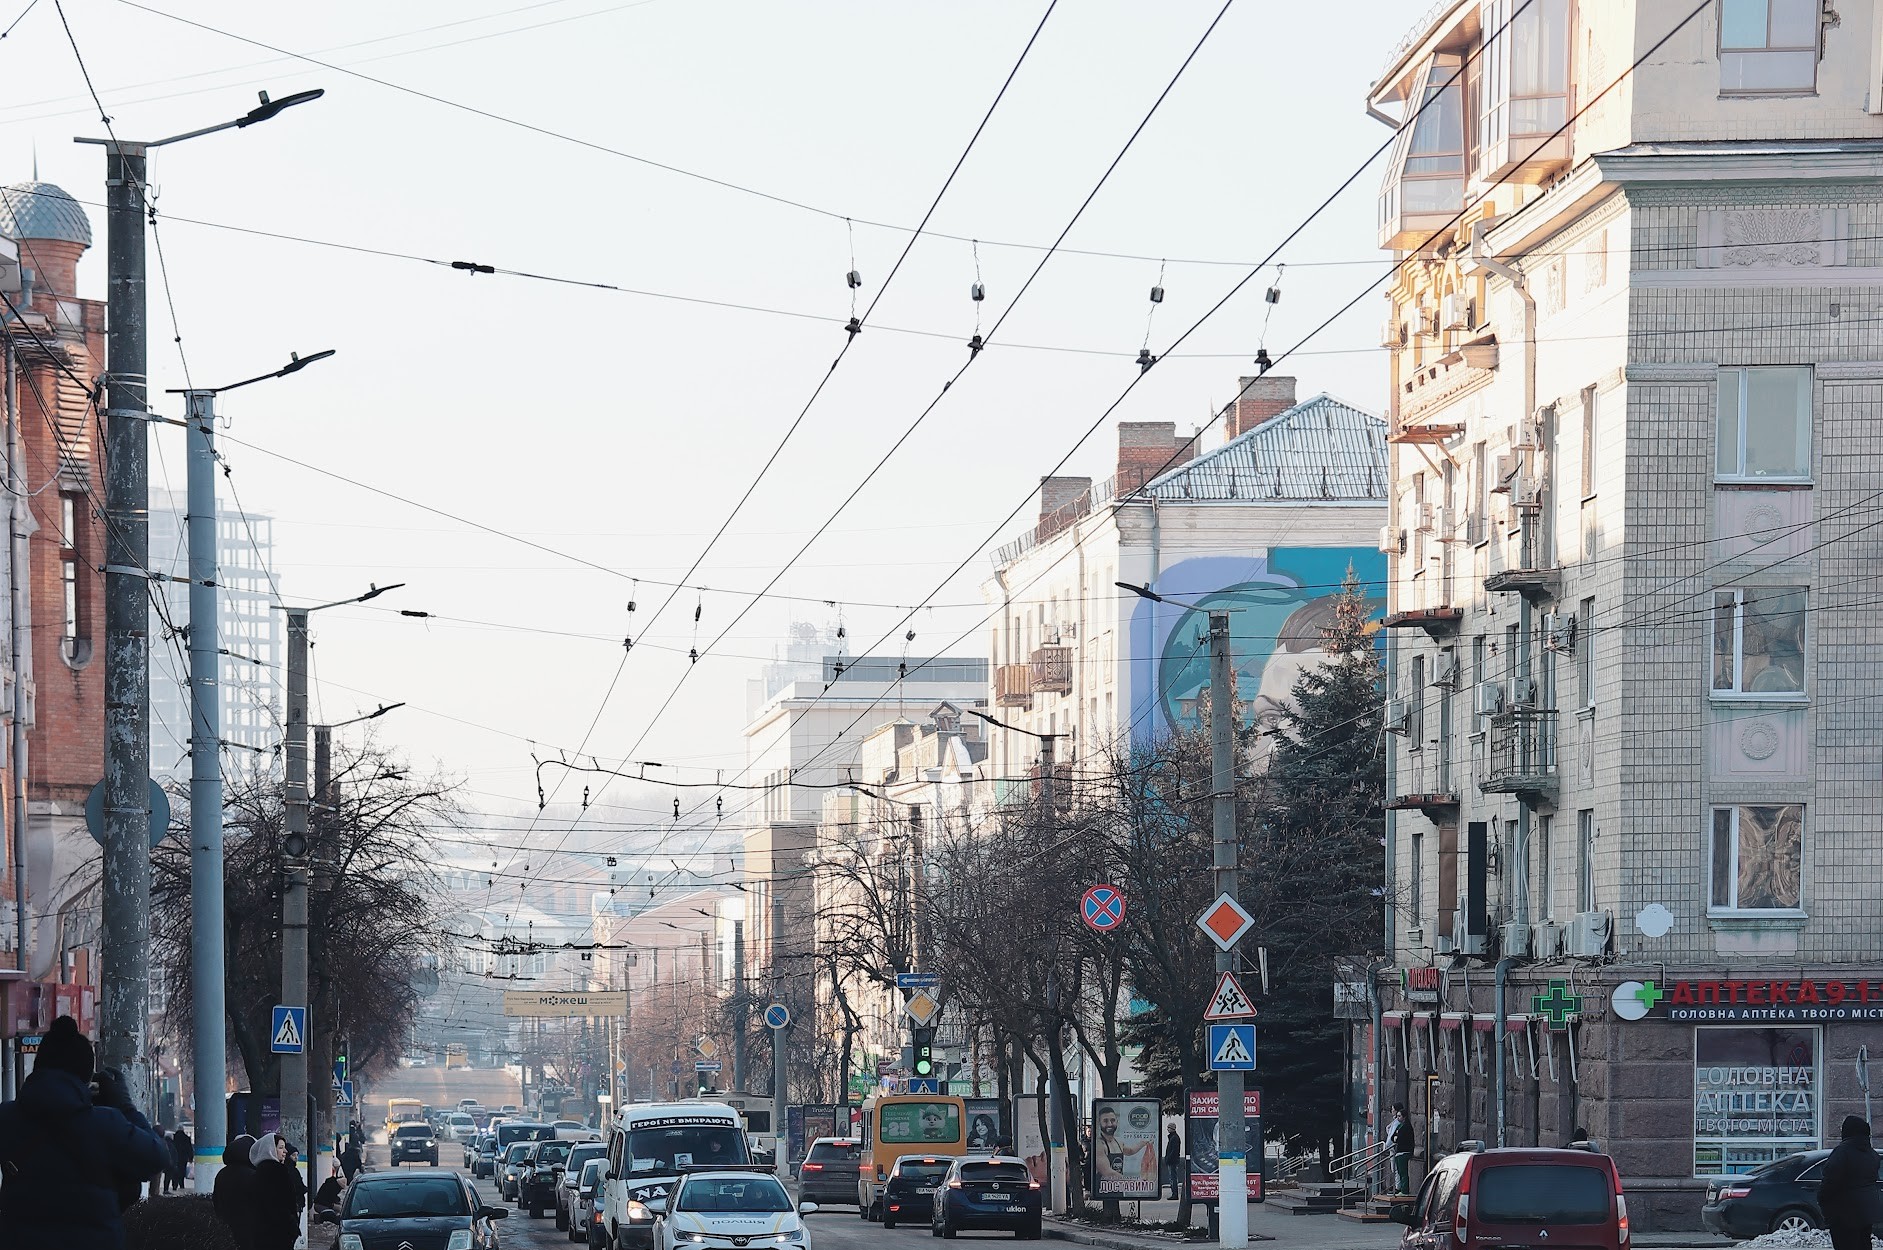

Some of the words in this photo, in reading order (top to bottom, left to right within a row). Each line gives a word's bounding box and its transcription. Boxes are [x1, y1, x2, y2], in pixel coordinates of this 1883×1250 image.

[1671, 1009, 1735, 1019] ГОЛОВНА
[1742, 1009, 1795, 1018] АПТЕКА
[1801, 1009, 1845, 1018] ТВОГО
[1852, 1008, 1883, 1018] МІСТ
[1696, 1067, 1810, 1085] ГОЛОВНА
[1191, 1097, 1219, 1105] ЗАХИС
[1243, 1096, 1257, 1104] ЛО
[1696, 1091, 1810, 1112] АПТЕКА
[1696, 1119, 1751, 1132] ТВОГО
[1758, 1119, 1810, 1132] МІСТА
[1100, 1181, 1154, 1193] ДОСТАВИМО
